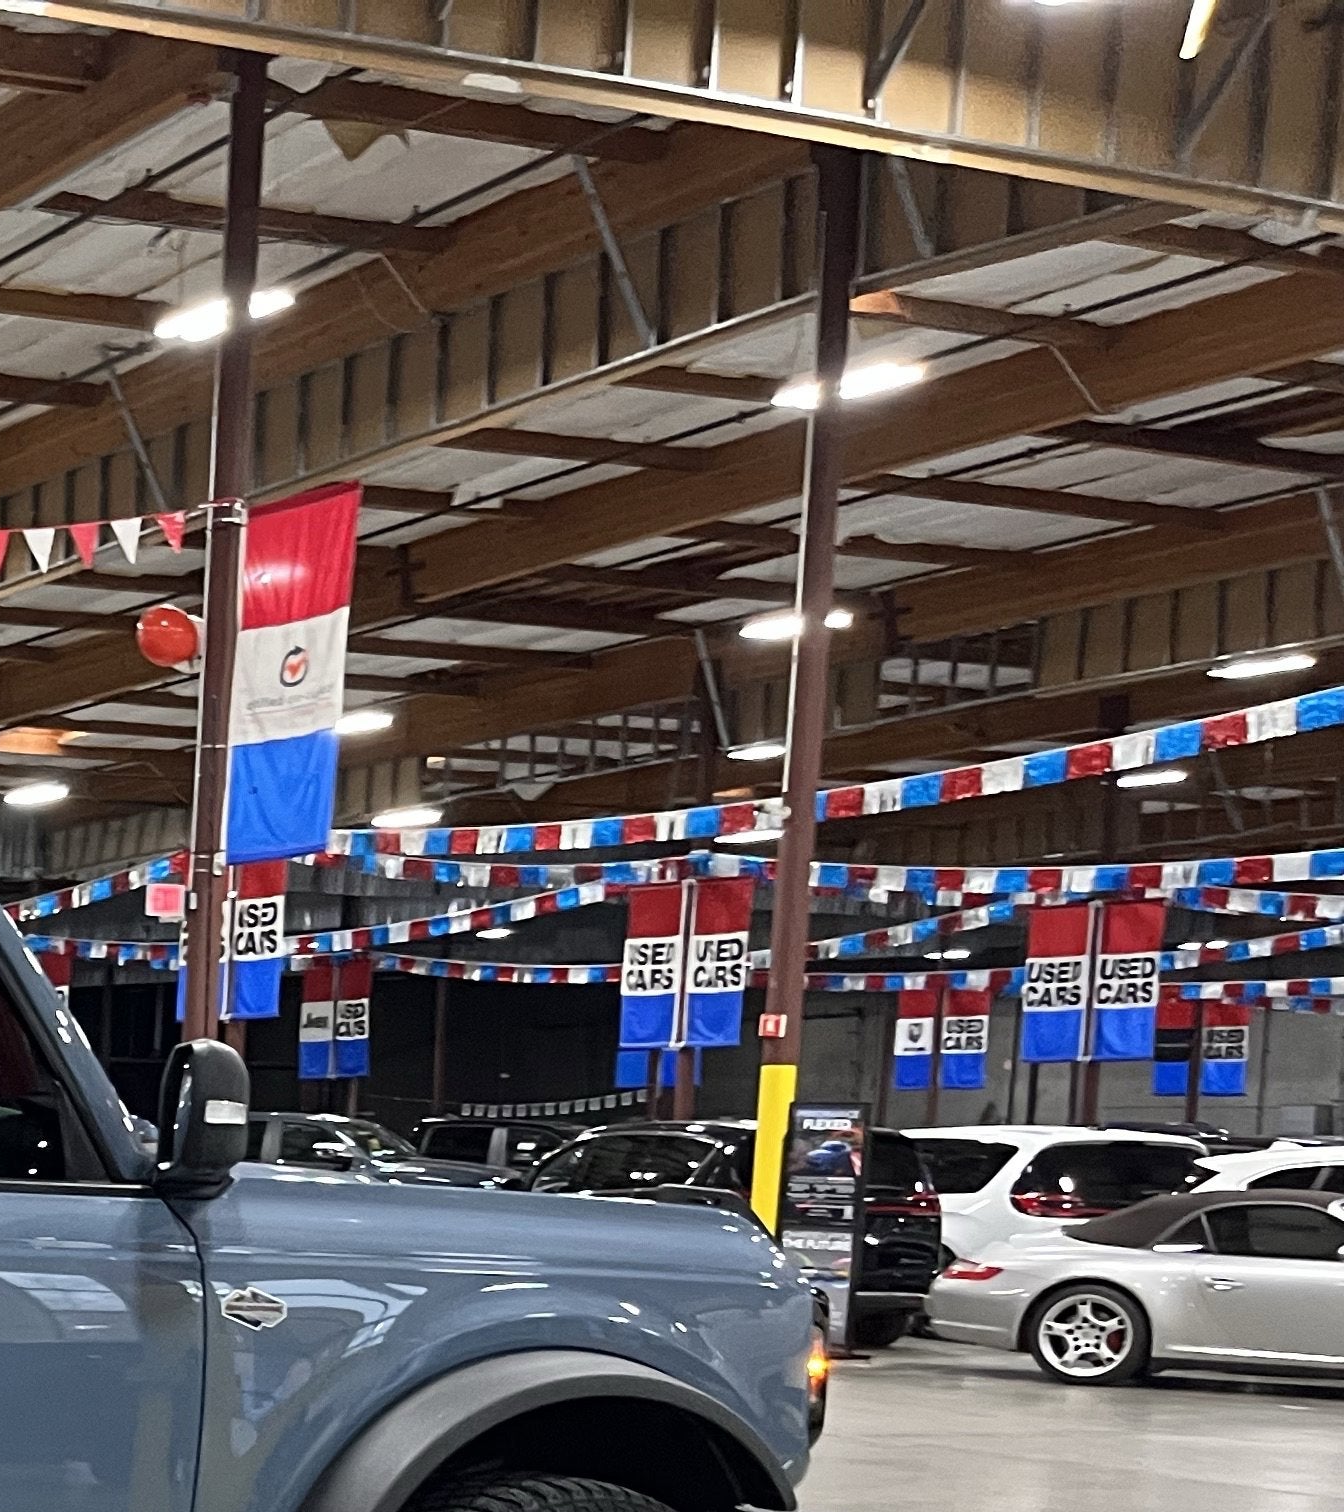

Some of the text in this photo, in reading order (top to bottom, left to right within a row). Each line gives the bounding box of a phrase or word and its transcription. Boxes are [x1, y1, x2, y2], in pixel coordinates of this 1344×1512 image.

[629, 942, 675, 966] USED
[696, 938, 744, 962] USED
[626, 968, 674, 991] CARS
[694, 964, 743, 988] CARS
[1028, 961, 1082, 984] USED
[1100, 957, 1156, 980] USED
[1027, 985, 1082, 1007] CARS
[1097, 981, 1154, 1004] CARS
[946, 1019, 984, 1034] USED
[1206, 1028, 1245, 1043] USED
[944, 1036, 983, 1050] CARS
